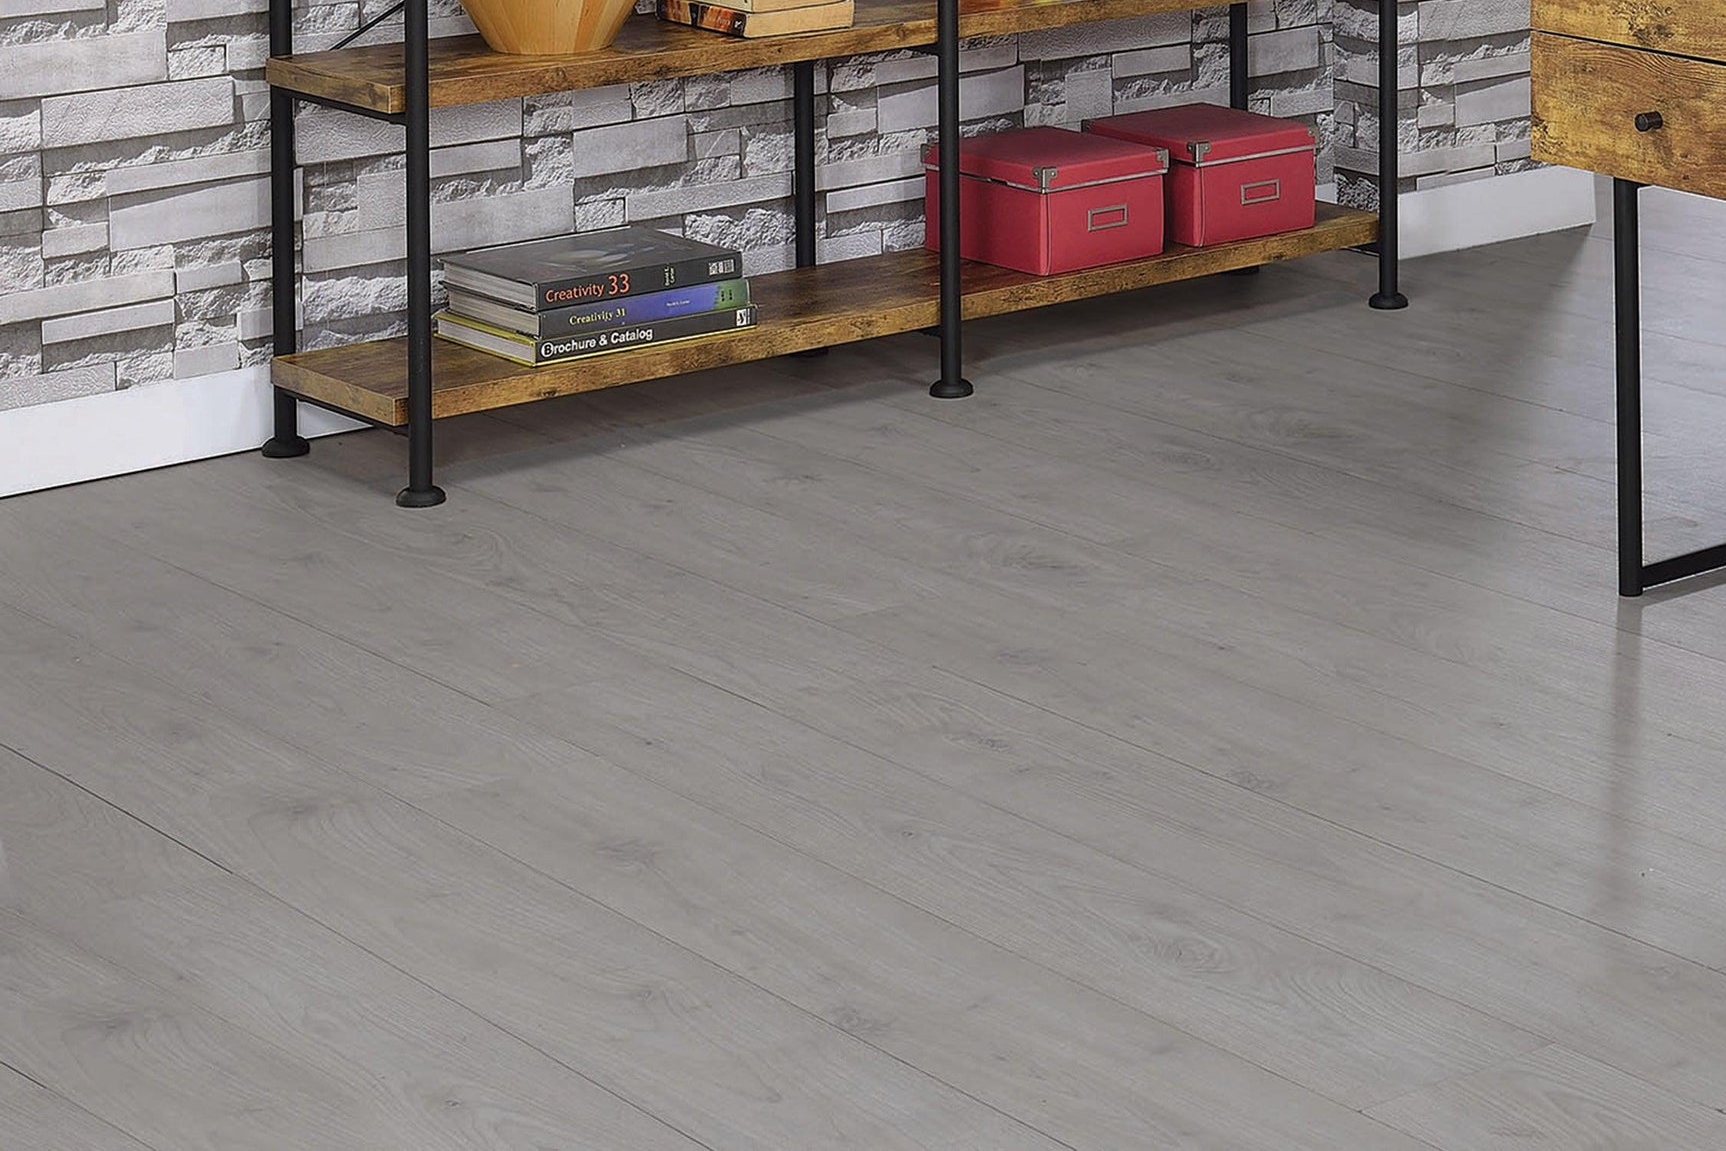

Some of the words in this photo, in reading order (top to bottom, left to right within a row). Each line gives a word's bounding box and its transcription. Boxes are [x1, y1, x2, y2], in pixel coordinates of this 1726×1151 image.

[546, 282, 605, 303] Creativity
[608, 274, 631, 296] 33
[569, 310, 614, 326] Creativity
[615, 306, 626, 320] 31
[541, 337, 596, 358] Brochure
[598, 334, 608, 346] &
[611, 328, 654, 345] Catalog
